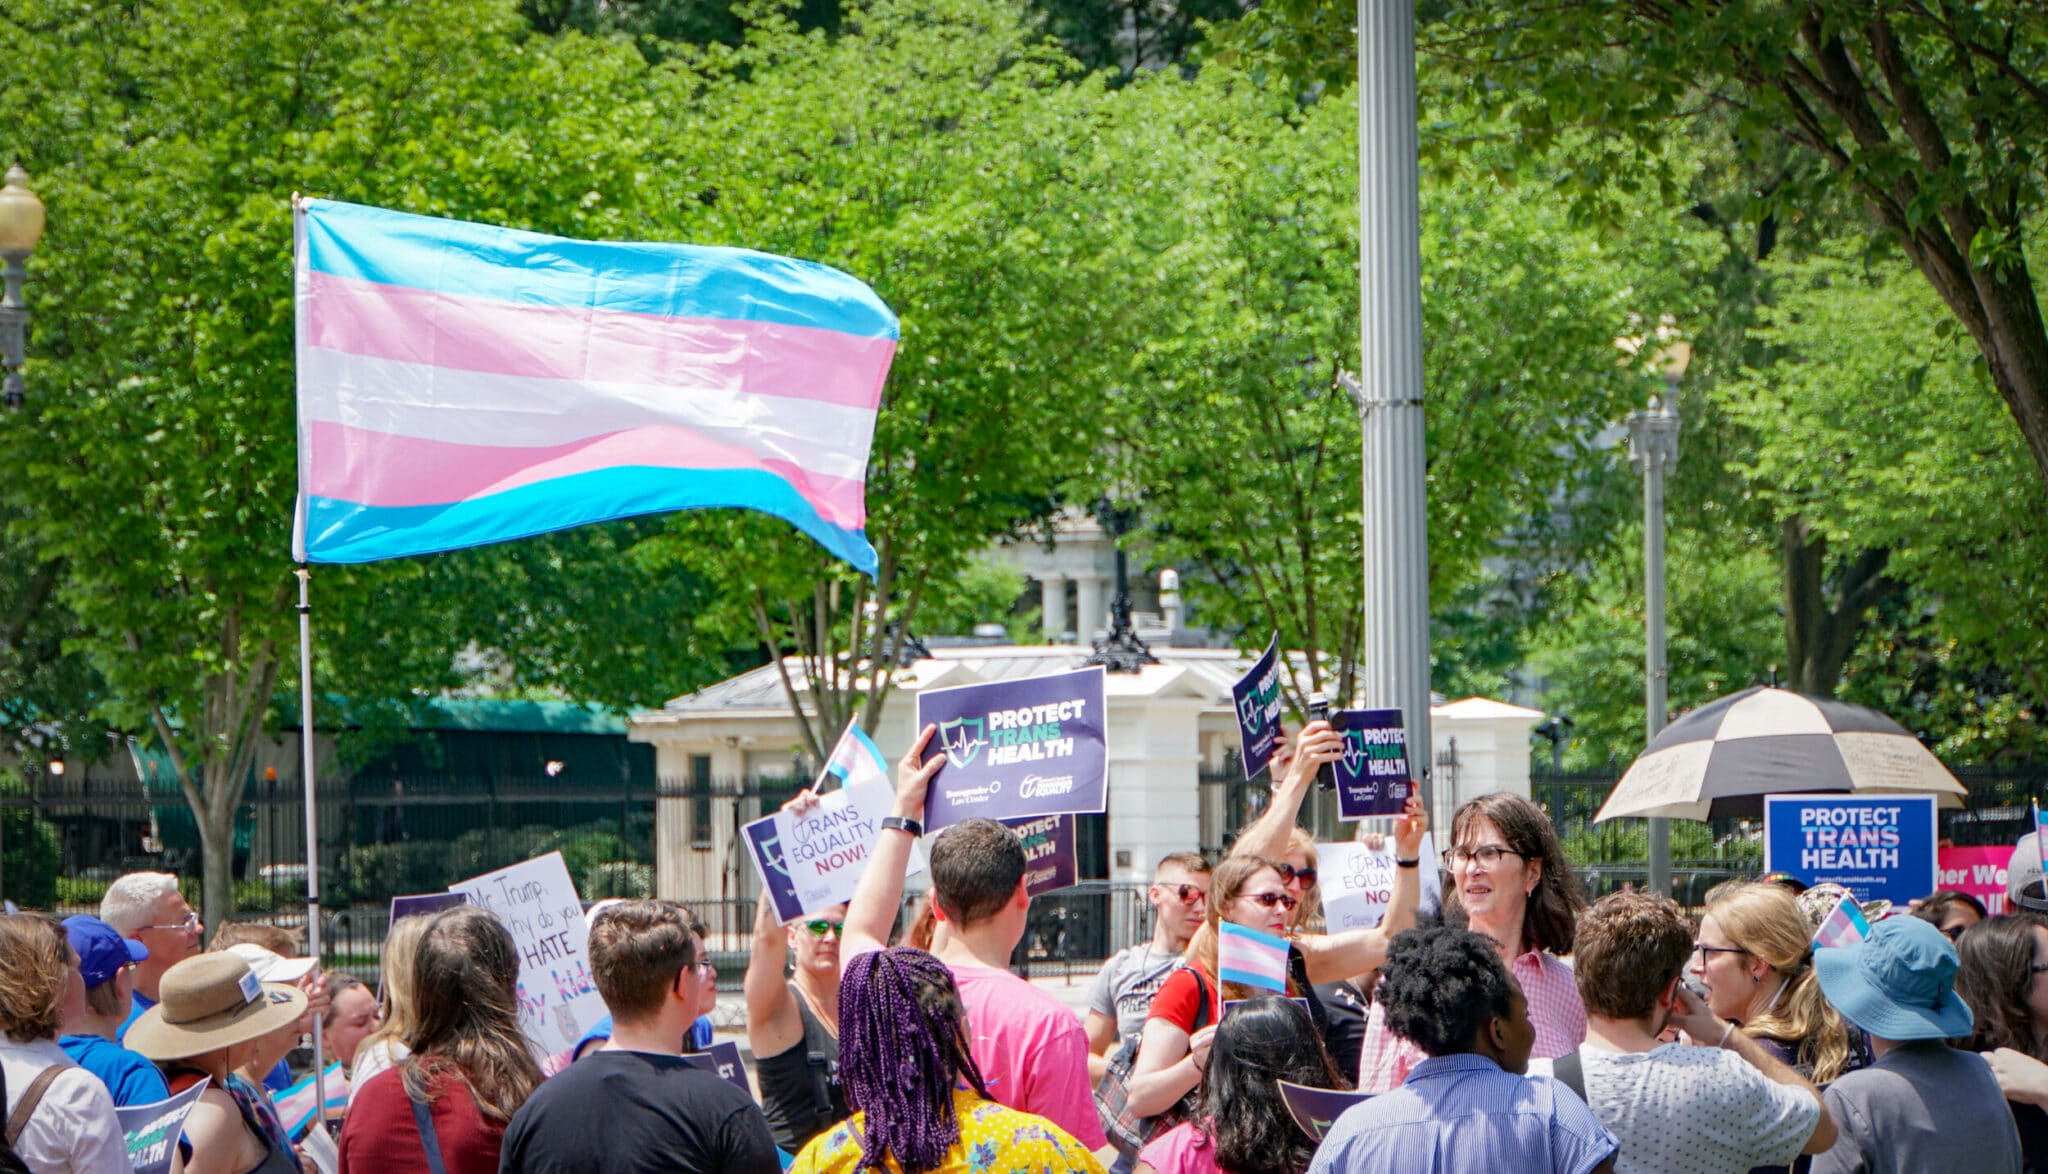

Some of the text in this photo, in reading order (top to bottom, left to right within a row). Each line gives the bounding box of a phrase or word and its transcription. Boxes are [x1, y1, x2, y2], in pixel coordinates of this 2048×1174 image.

[988, 699, 1086, 731] PROTECT
[989, 722, 1062, 748] TRANS
[1363, 728, 1405, 745] PROTEC
[987, 737, 1074, 766] HEALTH
[1368, 759, 1406, 776] HEALTH
[792, 804, 860, 845] TRANS
[1012, 815, 1062, 839] OTECT
[1801, 807, 1901, 826] PROTECT
[792, 818, 875, 864] EQUALITY
[1801, 825, 1901, 849] TRANS
[814, 843, 869, 876] NOW!
[1347, 852, 1398, 874] TRAN
[1802, 849, 1899, 870] HEALTH
[1343, 873, 1394, 890] EQUA
[1938, 864, 1968, 885] her
[1365, 889, 1391, 905] NO
[508, 904, 580, 941] hy do you
[521, 930, 577, 970] HATE
